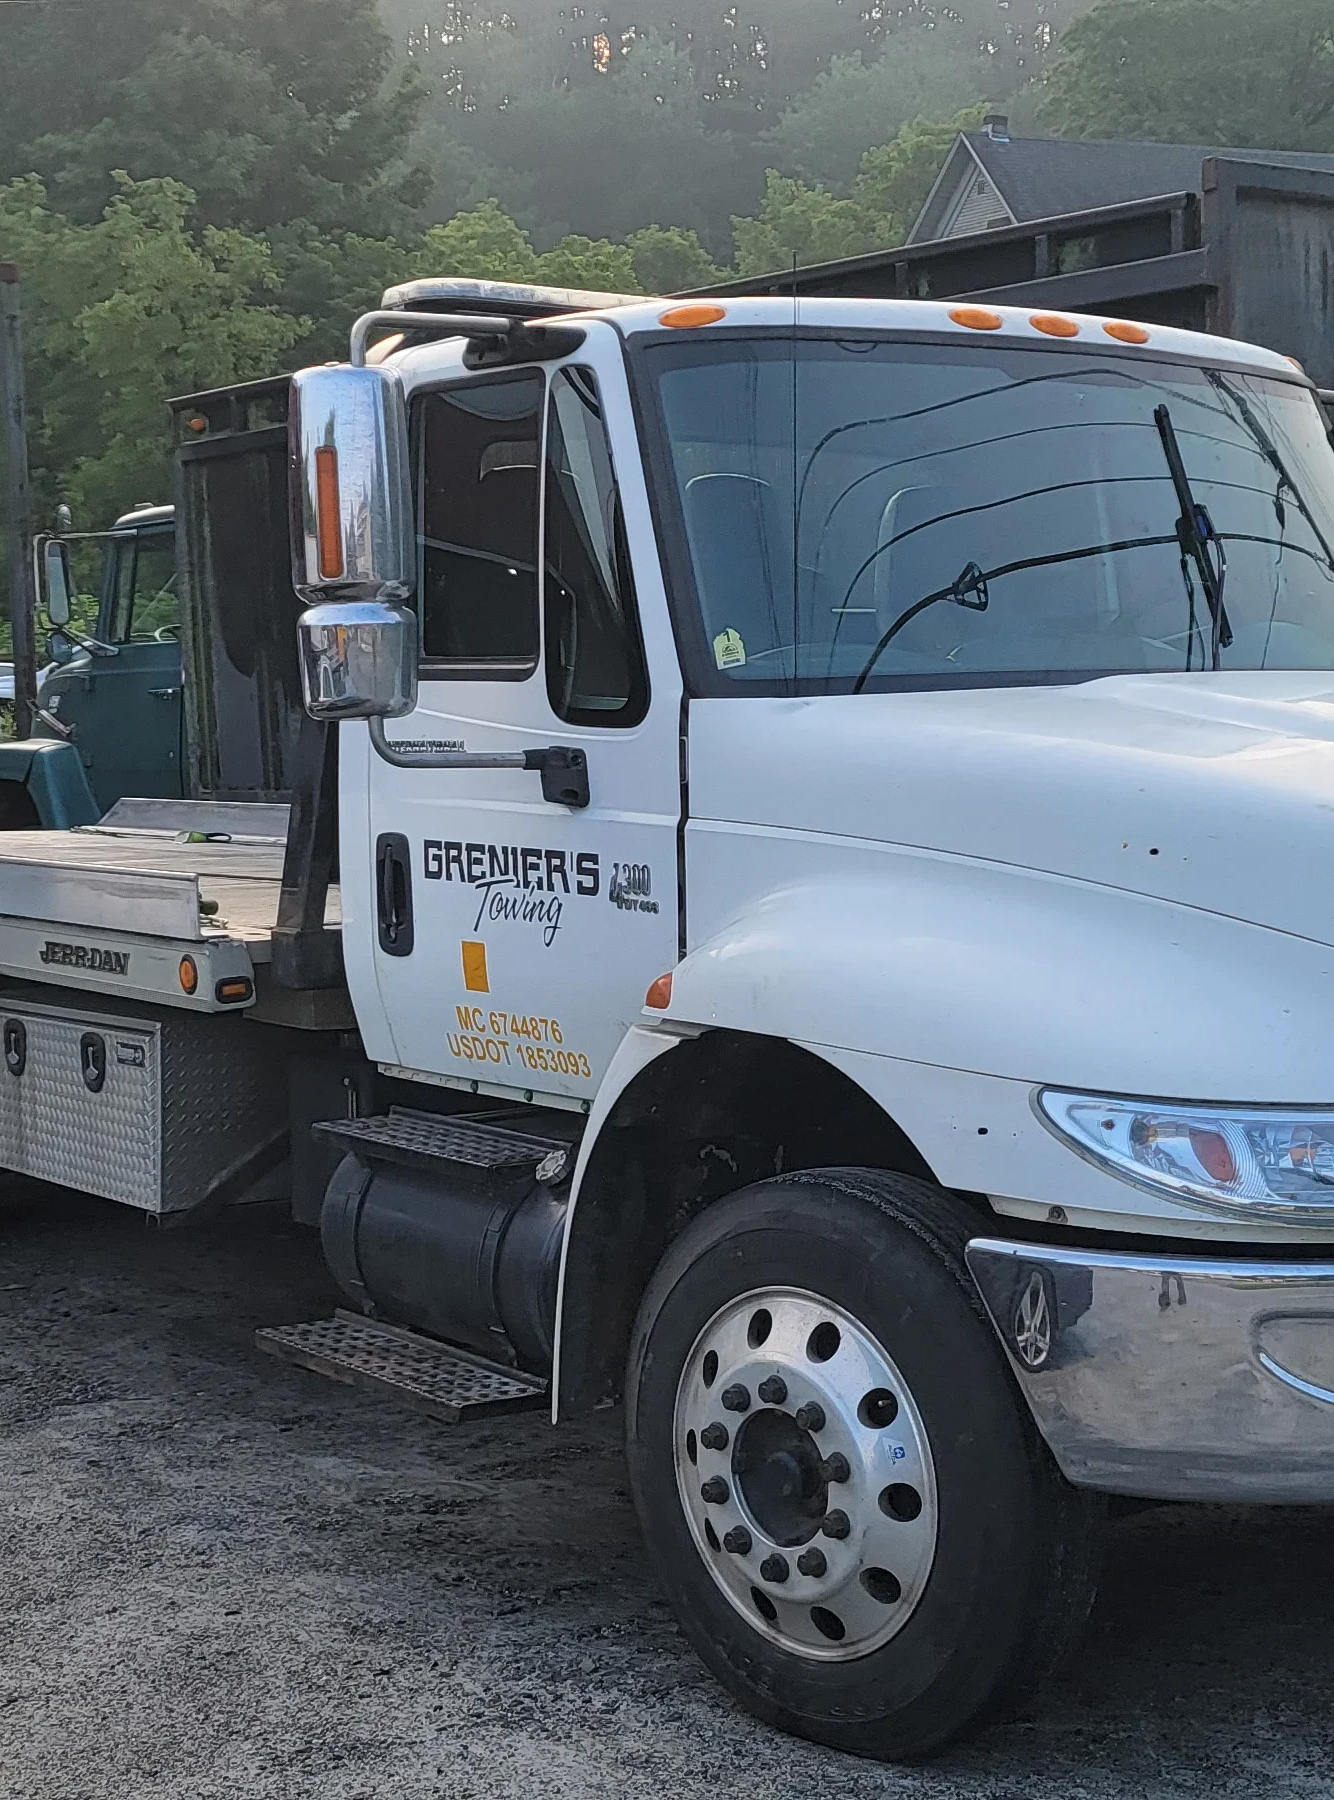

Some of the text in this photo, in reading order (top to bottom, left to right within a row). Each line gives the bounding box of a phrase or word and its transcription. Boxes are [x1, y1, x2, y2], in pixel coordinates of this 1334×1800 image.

[424, 839, 600, 896] GRENIER'S
[609, 862, 651, 902] 4300
[473, 879, 563, 947] Towing
[456, 1005, 563, 1045] MC 6744876
[446, 1032, 592, 1078] USDOT 1853093
